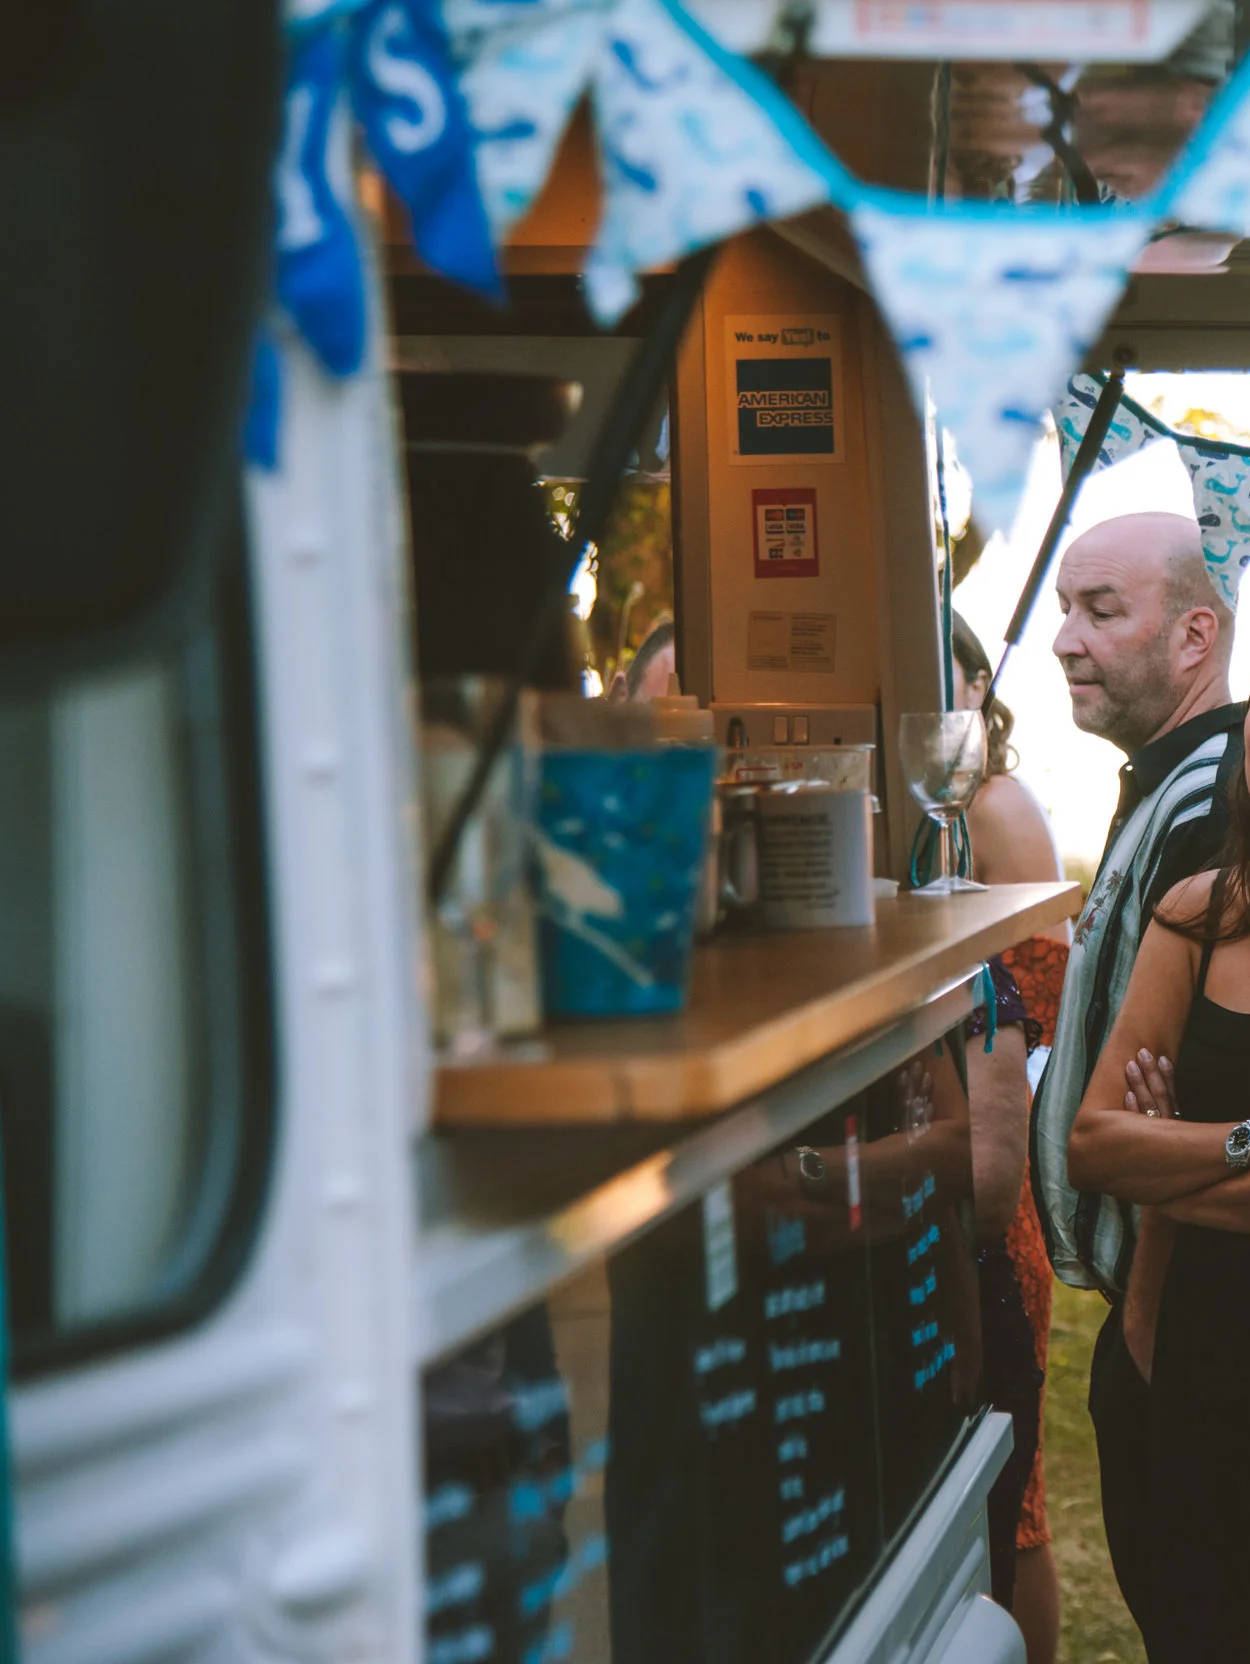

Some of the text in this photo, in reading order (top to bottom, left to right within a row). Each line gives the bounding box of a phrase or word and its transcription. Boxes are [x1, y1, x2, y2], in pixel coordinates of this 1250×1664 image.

[735, 332, 754, 342] We
[757, 333, 779, 344] say
[817, 331, 831, 341] to
[738, 393, 826, 406] AMERICAN
[759, 411, 833, 425] EXPRESS
